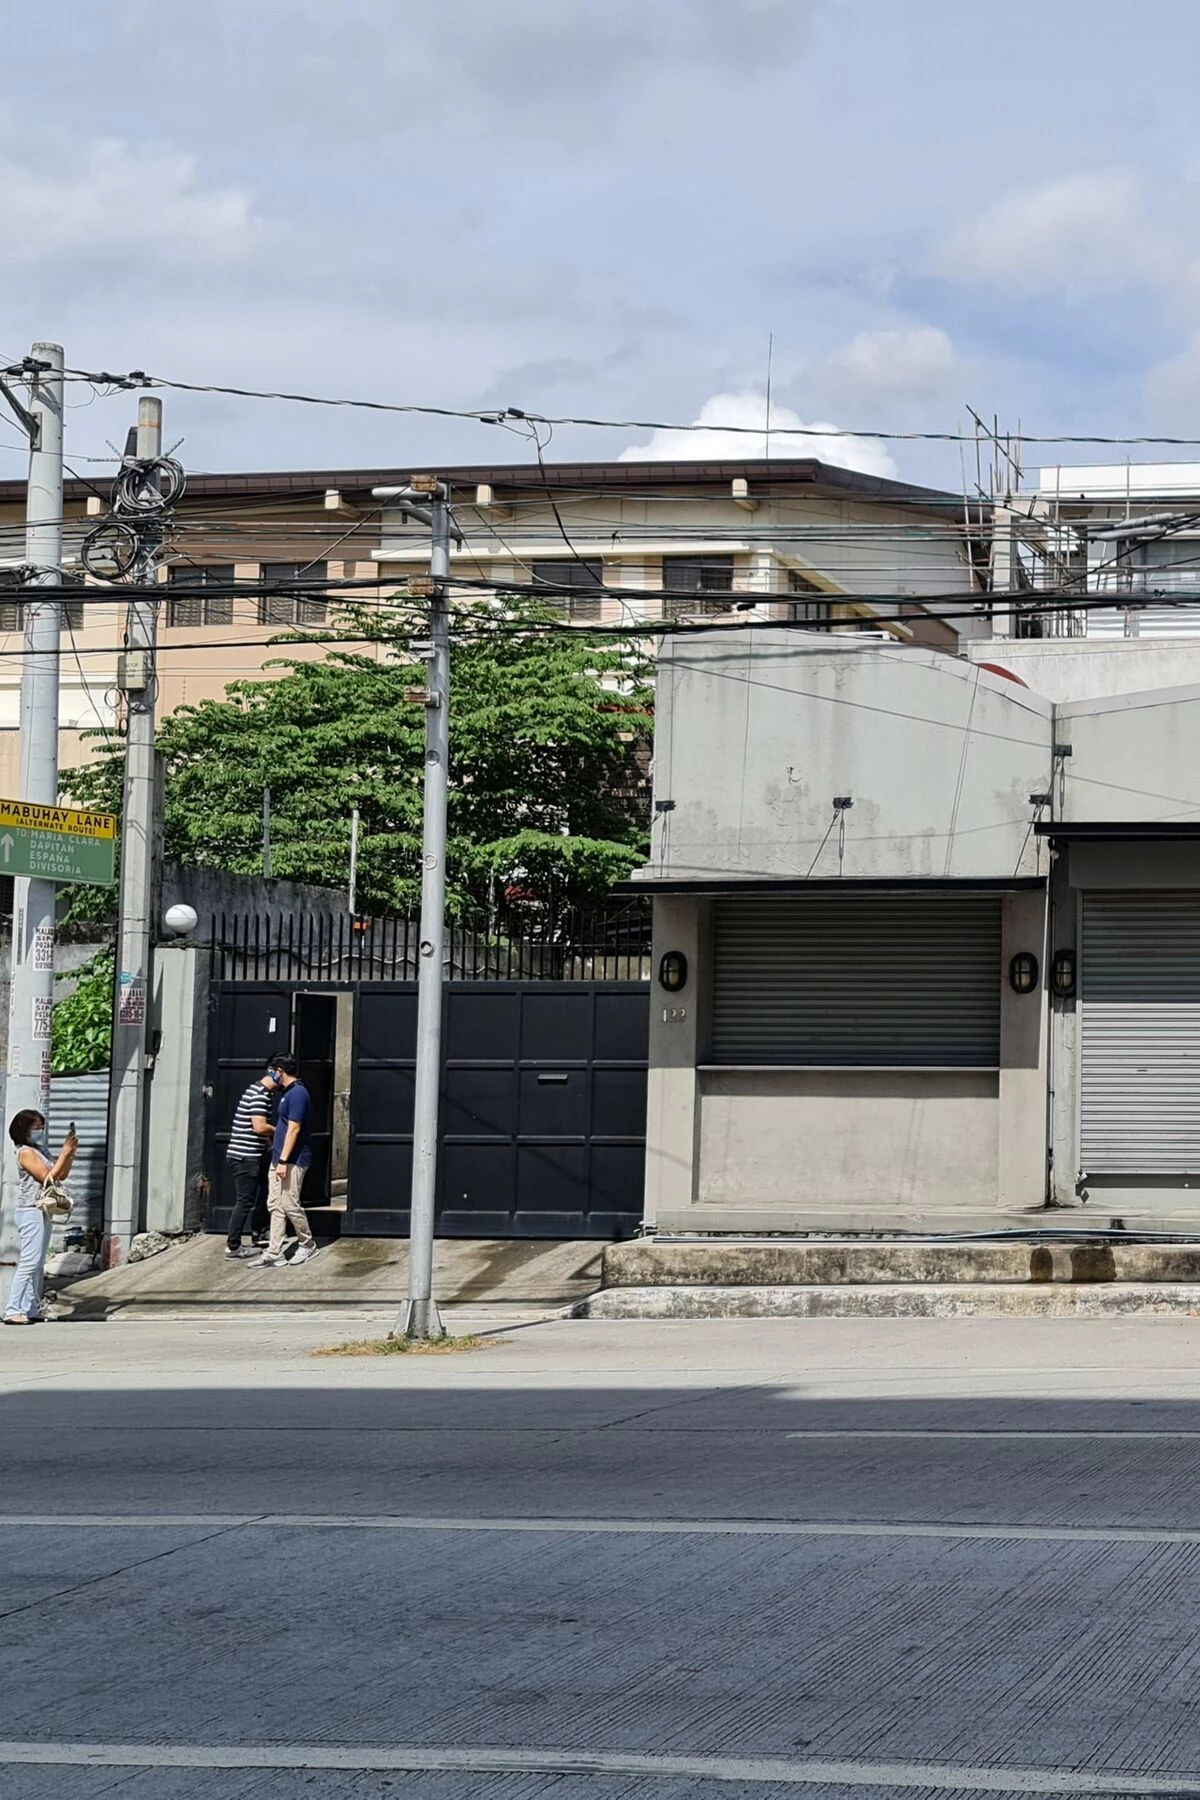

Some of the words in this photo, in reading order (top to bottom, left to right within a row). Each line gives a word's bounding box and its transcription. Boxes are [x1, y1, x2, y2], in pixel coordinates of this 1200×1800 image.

[0, 803, 69, 823] MABUHAY
[77, 814, 111, 829] LANE
[16, 818, 63, 831] (ALTERNATE
[68, 825, 96, 835] ROUTE)
[30, 829, 63, 842] MARIA
[69, 835, 101, 847] CLARA
[30, 840, 75, 853] DAPITAN
[30, 850, 70, 863] ESPAÑA
[29, 861, 81, 874] DIVISORIA
